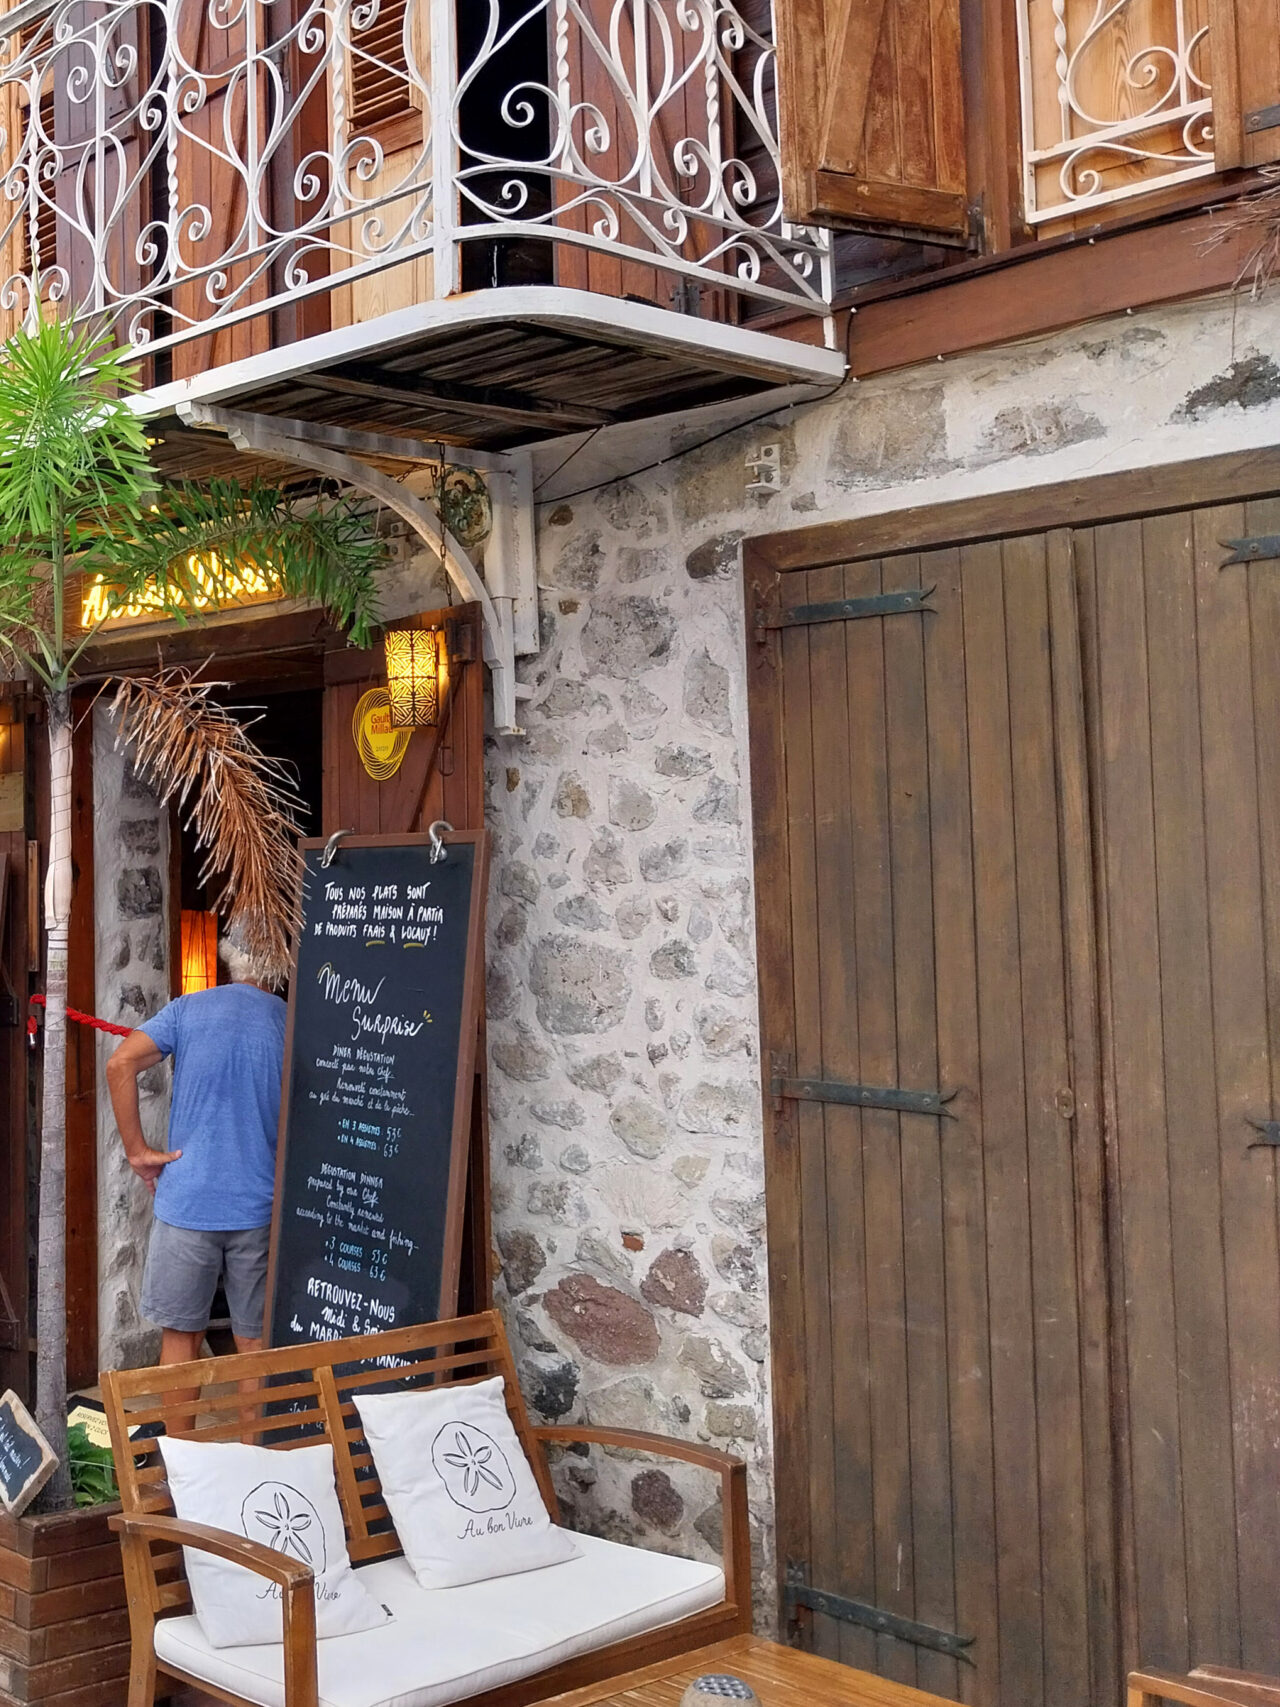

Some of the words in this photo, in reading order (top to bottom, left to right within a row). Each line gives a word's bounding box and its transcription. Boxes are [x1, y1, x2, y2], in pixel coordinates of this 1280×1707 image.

[325, 881, 343, 901] TOUS
[349, 886, 366, 900] NOS
[372, 884, 398, 900] PLATS
[407, 881, 431, 899] SONT
[332, 900, 367, 920] PRÉPARÉS
[314, 922, 323, 936] DE
[318, 966, 386, 1004] Menu
[351, 1005, 424, 1045] Surprise
[290, 1314, 303, 1332] du
[321, 1306, 348, 1328] Midi
[457, 1519, 484, 1539] Au
[505, 1511, 533, 1530] Vivre
